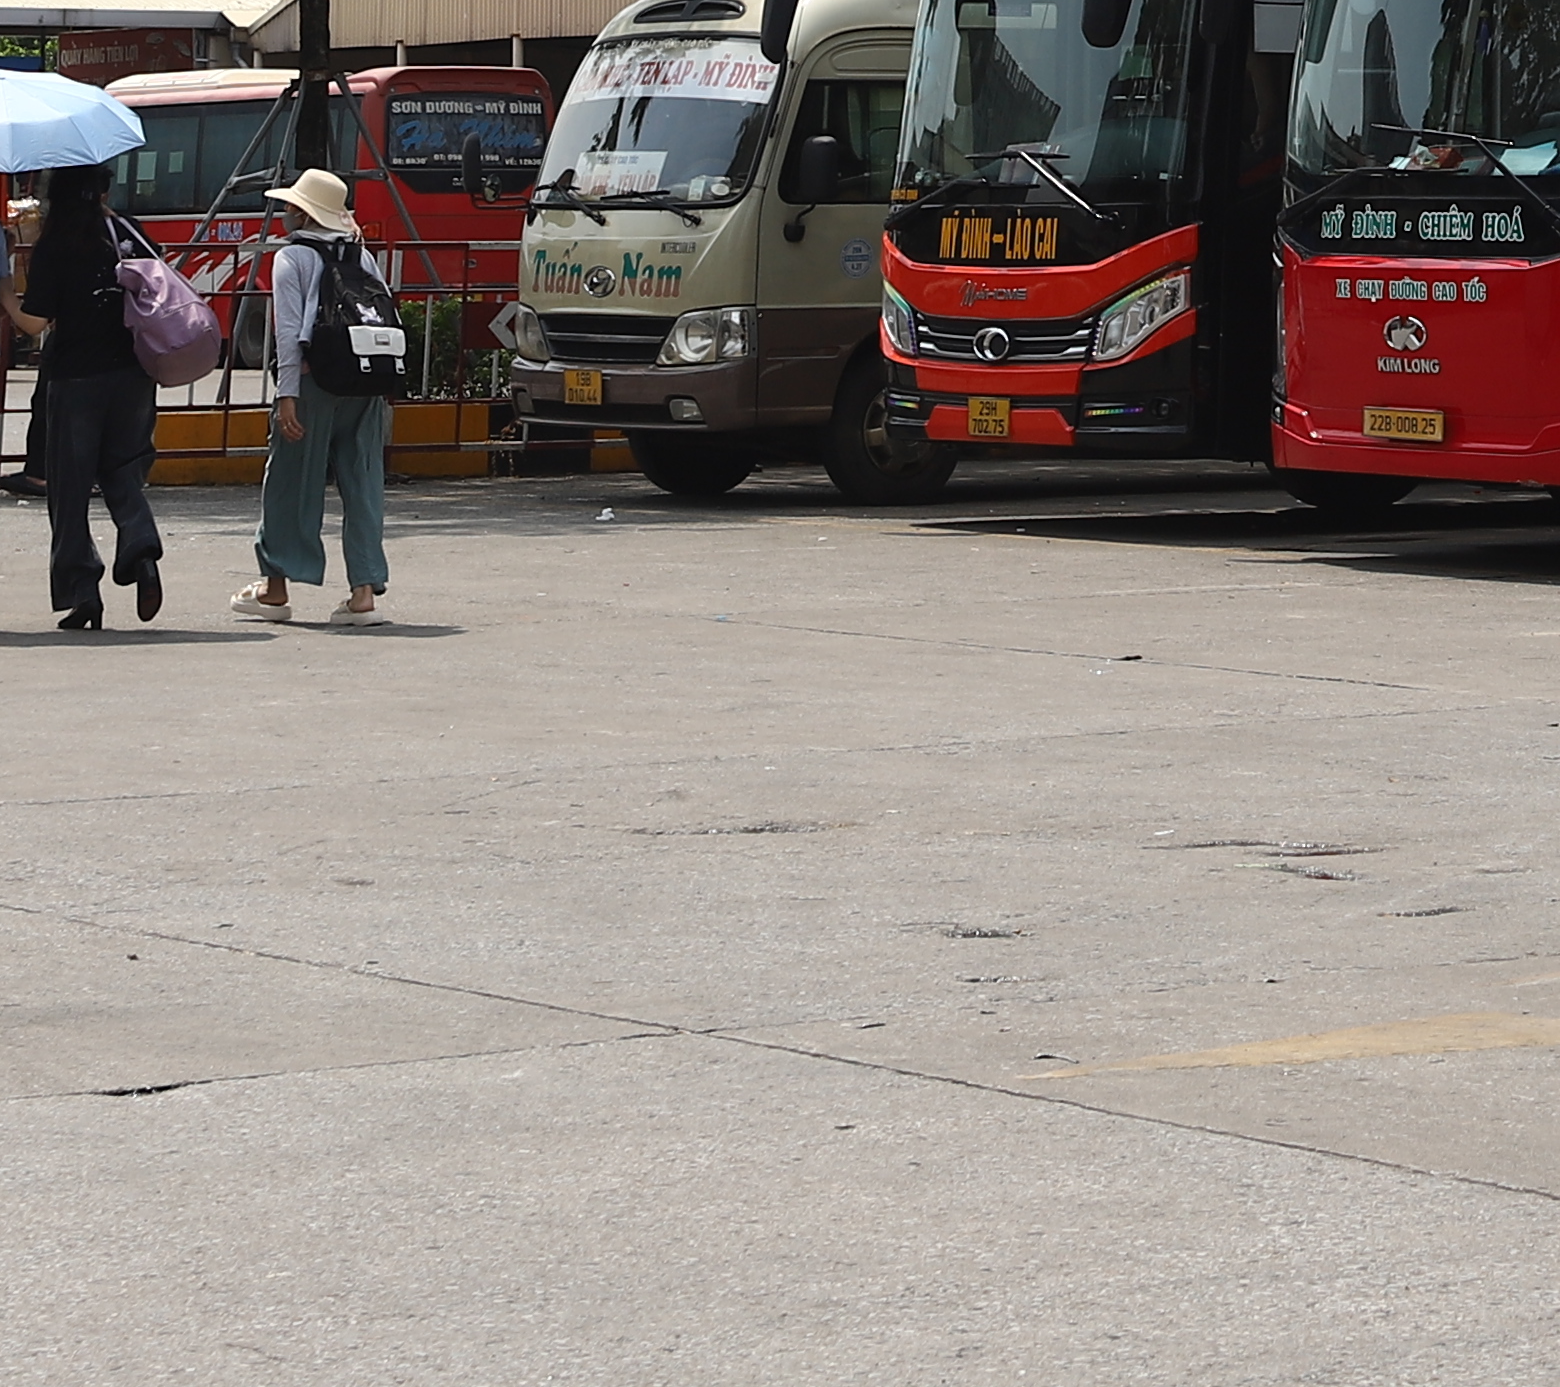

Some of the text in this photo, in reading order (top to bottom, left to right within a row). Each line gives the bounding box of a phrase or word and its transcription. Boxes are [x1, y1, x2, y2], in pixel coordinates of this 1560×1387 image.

[699, 53, 731, 88] MỸ
[391, 100, 542, 115] SƠN DƯƠNG MỸ ĐÌNH
[1320, 203, 1525, 242] MỸ ĐÌNH CHIÊM HOÁ
[961, 208, 992, 259] ĐÌNH
[1005, 208, 1032, 260] LÀO
[1034, 217, 1058, 260] CAI
[532, 241, 682, 298] Tuấn Nam
[1335, 276, 1487, 303] XE CHẠY ĐƯỜNG CAO TỐC
[1377, 356, 1441, 374] KIM LONG
[575, 372, 592, 386] 19B
[568, 388, 598, 403] 010.44
[979, 400, 998, 417] 29H
[1369, 413, 1437, 435] 22B-008.25
